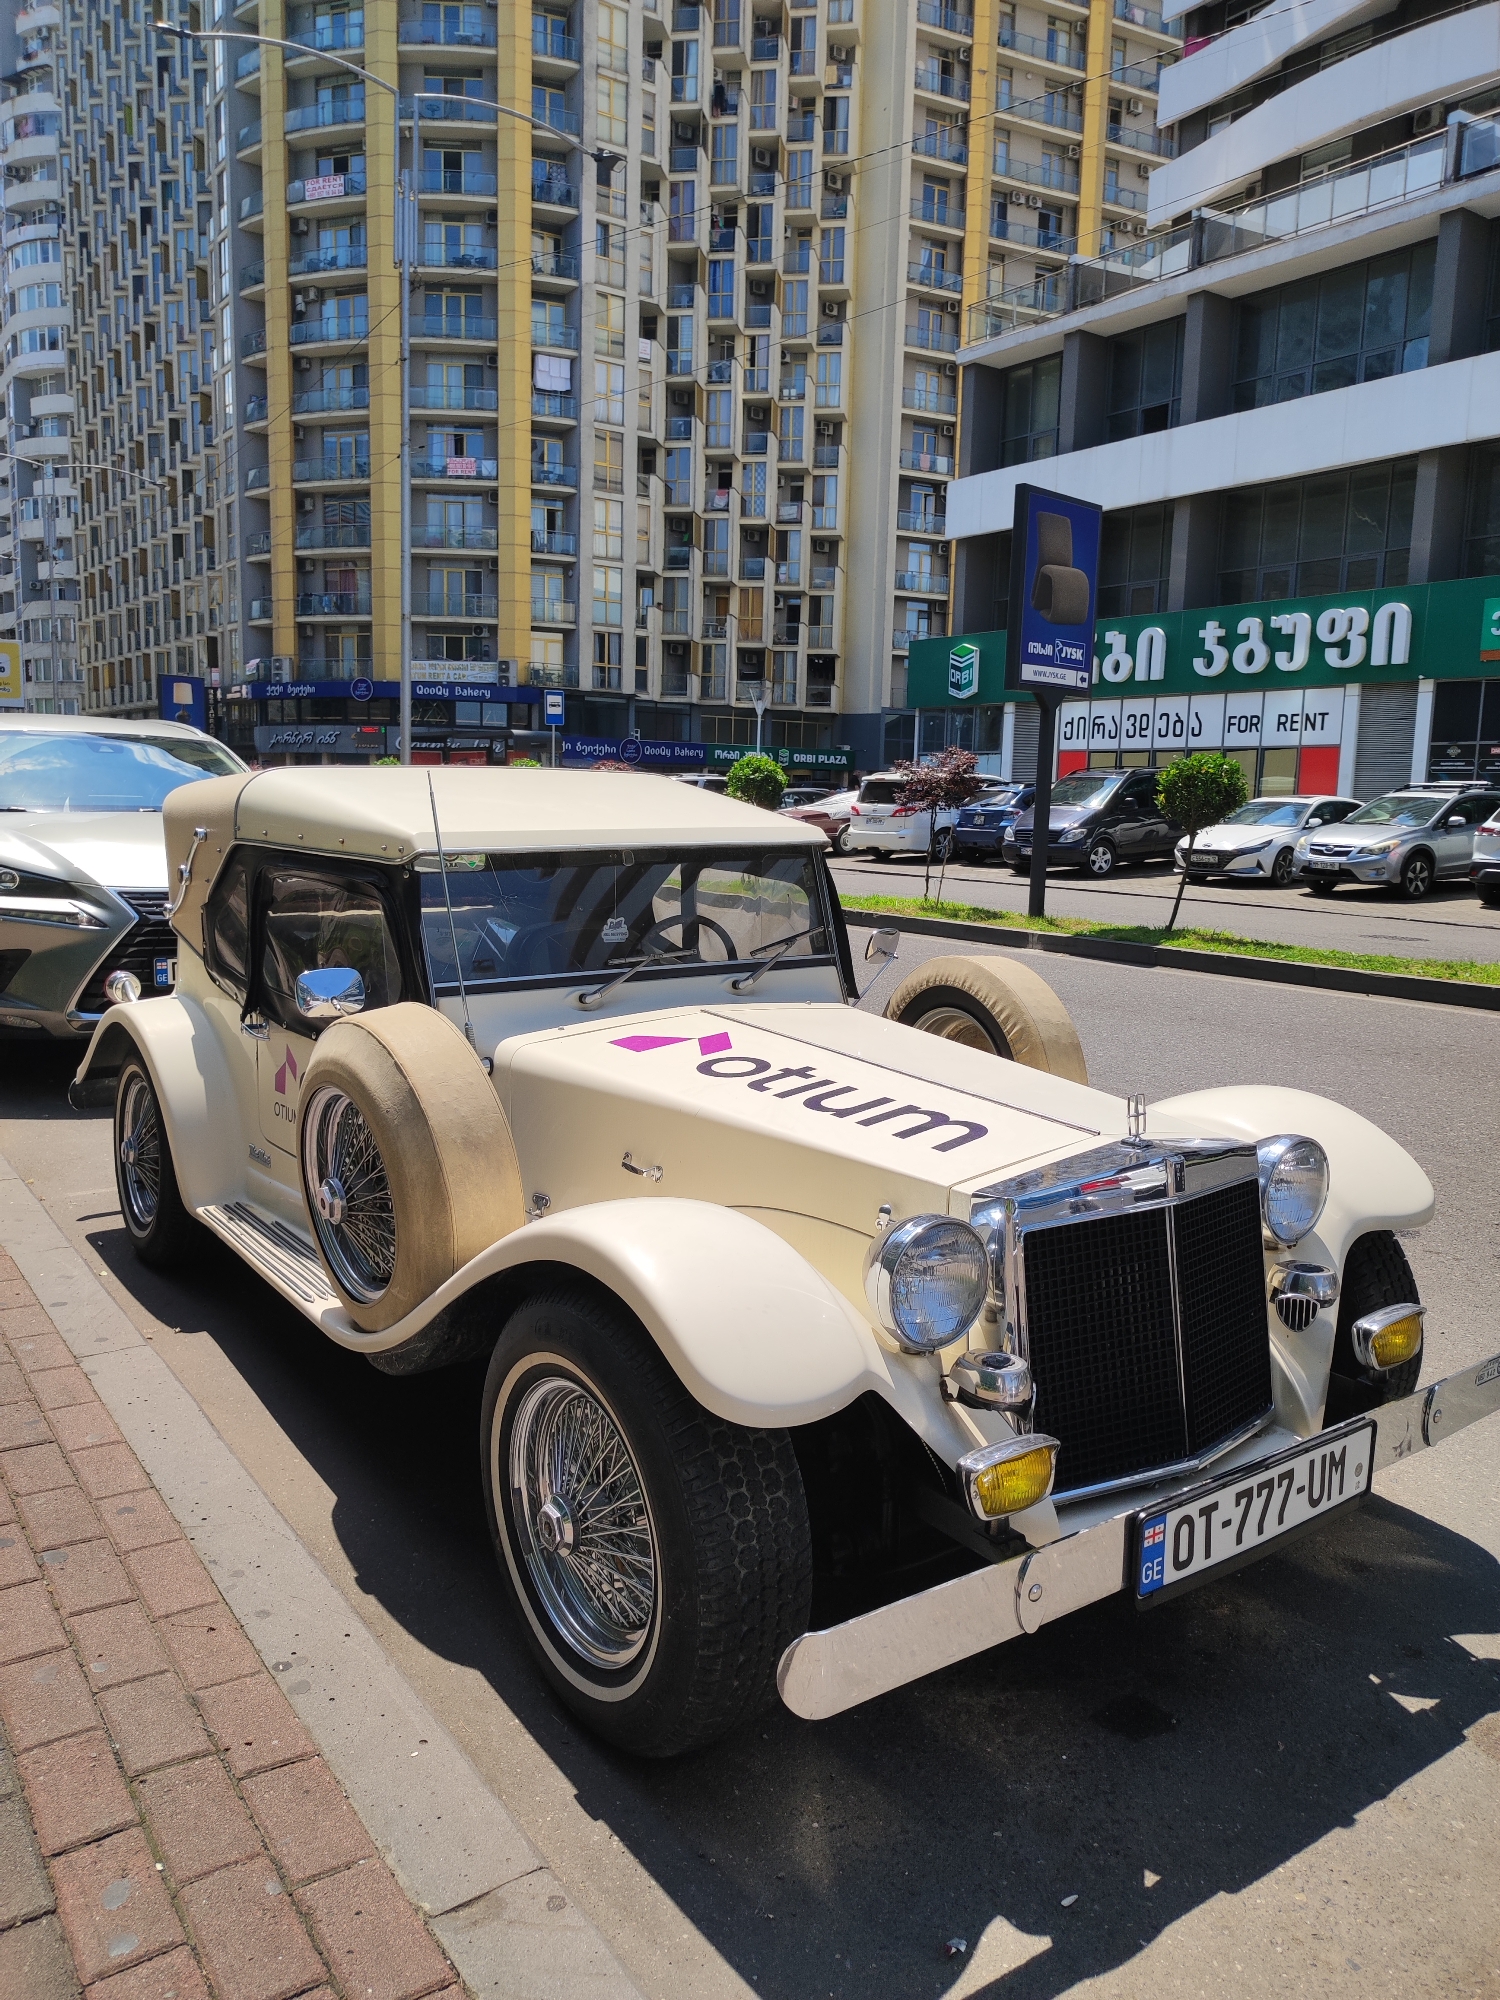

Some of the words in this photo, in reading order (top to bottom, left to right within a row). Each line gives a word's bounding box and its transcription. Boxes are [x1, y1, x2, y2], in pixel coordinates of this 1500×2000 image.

[306, 179, 320, 187] FOR
[322, 175, 342, 184] RENT
[1192, 602, 1413, 677] ჯგუფი
[1061, 646, 1084, 661] JYSK
[950, 667, 973, 685] ORBI
[1032, 669, 1067, 681] WWW.JYSK.GE
[416, 684, 449, 697] QooQy
[455, 686, 491, 699] Bakery
[1227, 714, 1261, 734] FOR
[1276, 711, 1330, 733] RENT
[644, 745, 671, 758] QooQy
[674, 746, 704, 759] Bakery
[793, 753, 816, 763] ORBI
[818, 754, 847, 765] PLAZA
[156, 973, 168, 982] GE
[696, 1056, 989, 1153] otium
[1172, 1445, 1347, 1572] OT-777-UM
[1142, 1557, 1162, 1584] GE
